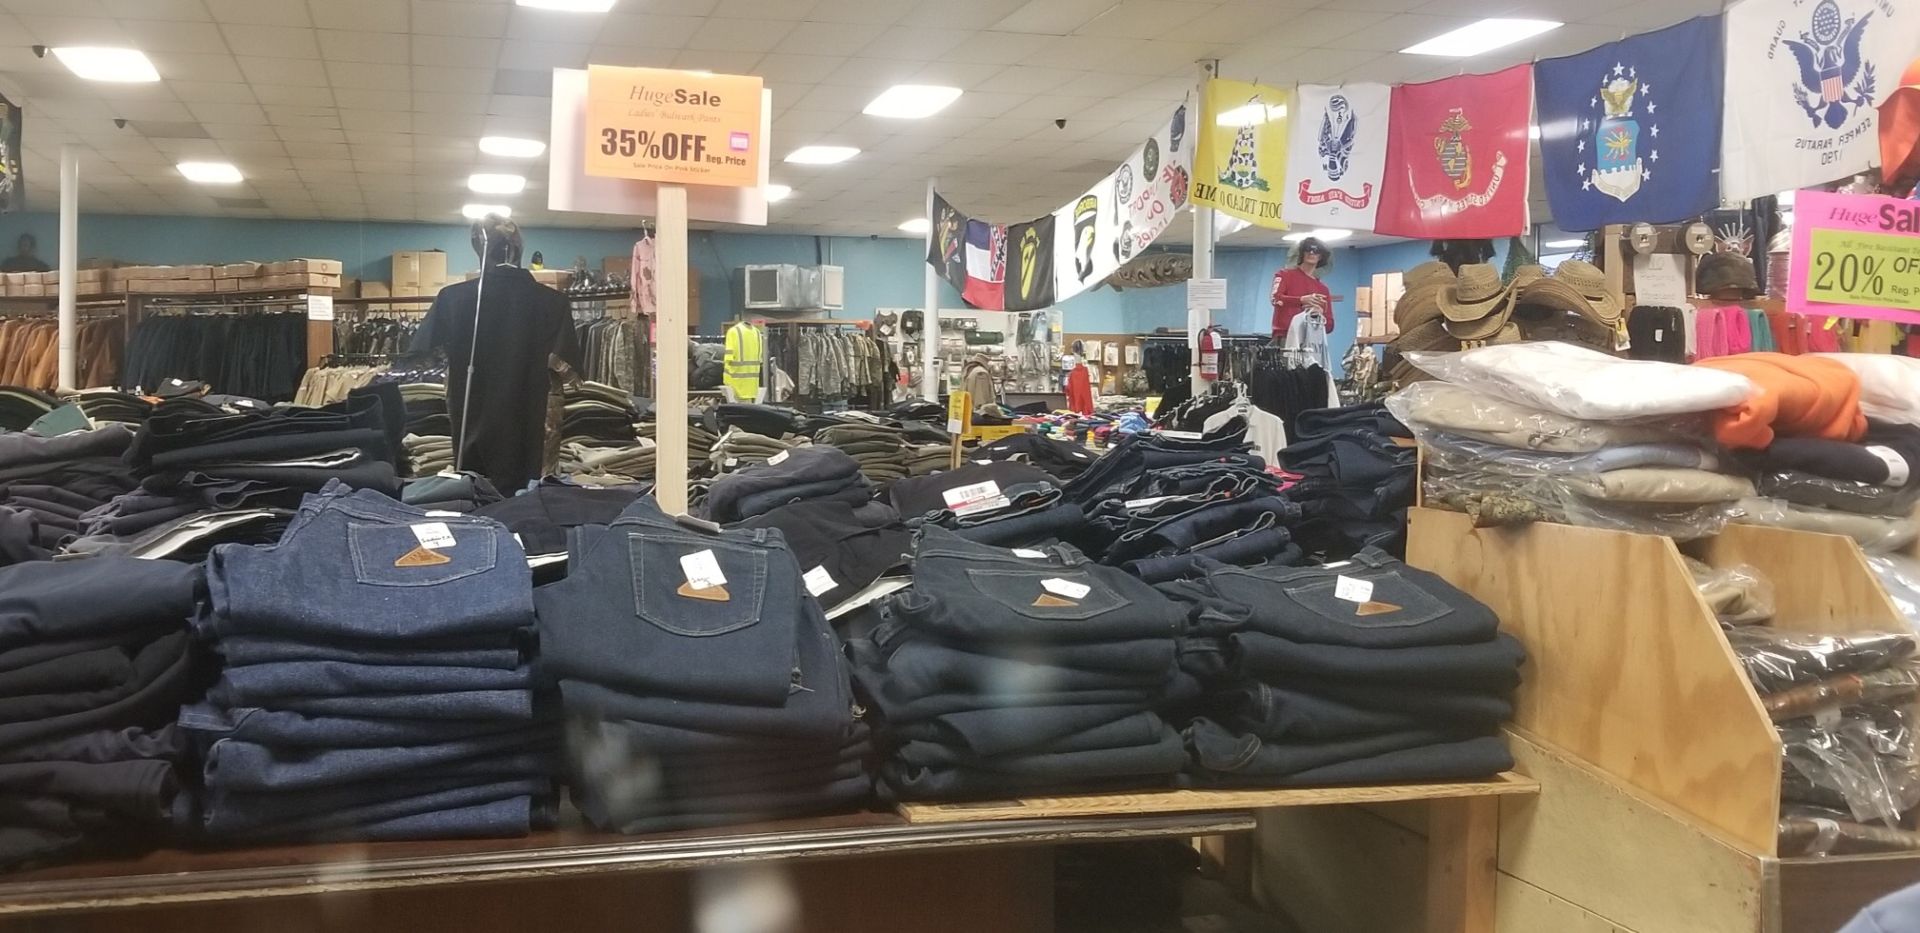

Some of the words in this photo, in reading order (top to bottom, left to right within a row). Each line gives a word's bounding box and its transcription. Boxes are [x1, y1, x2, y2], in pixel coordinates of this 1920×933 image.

[706, 154, 723, 165] Reg.
[725, 156, 746, 166] Price
[1814, 251, 1885, 295] 20%
[1893, 256, 1920, 275] OF
[1891, 285, 1911, 297] Reg.
